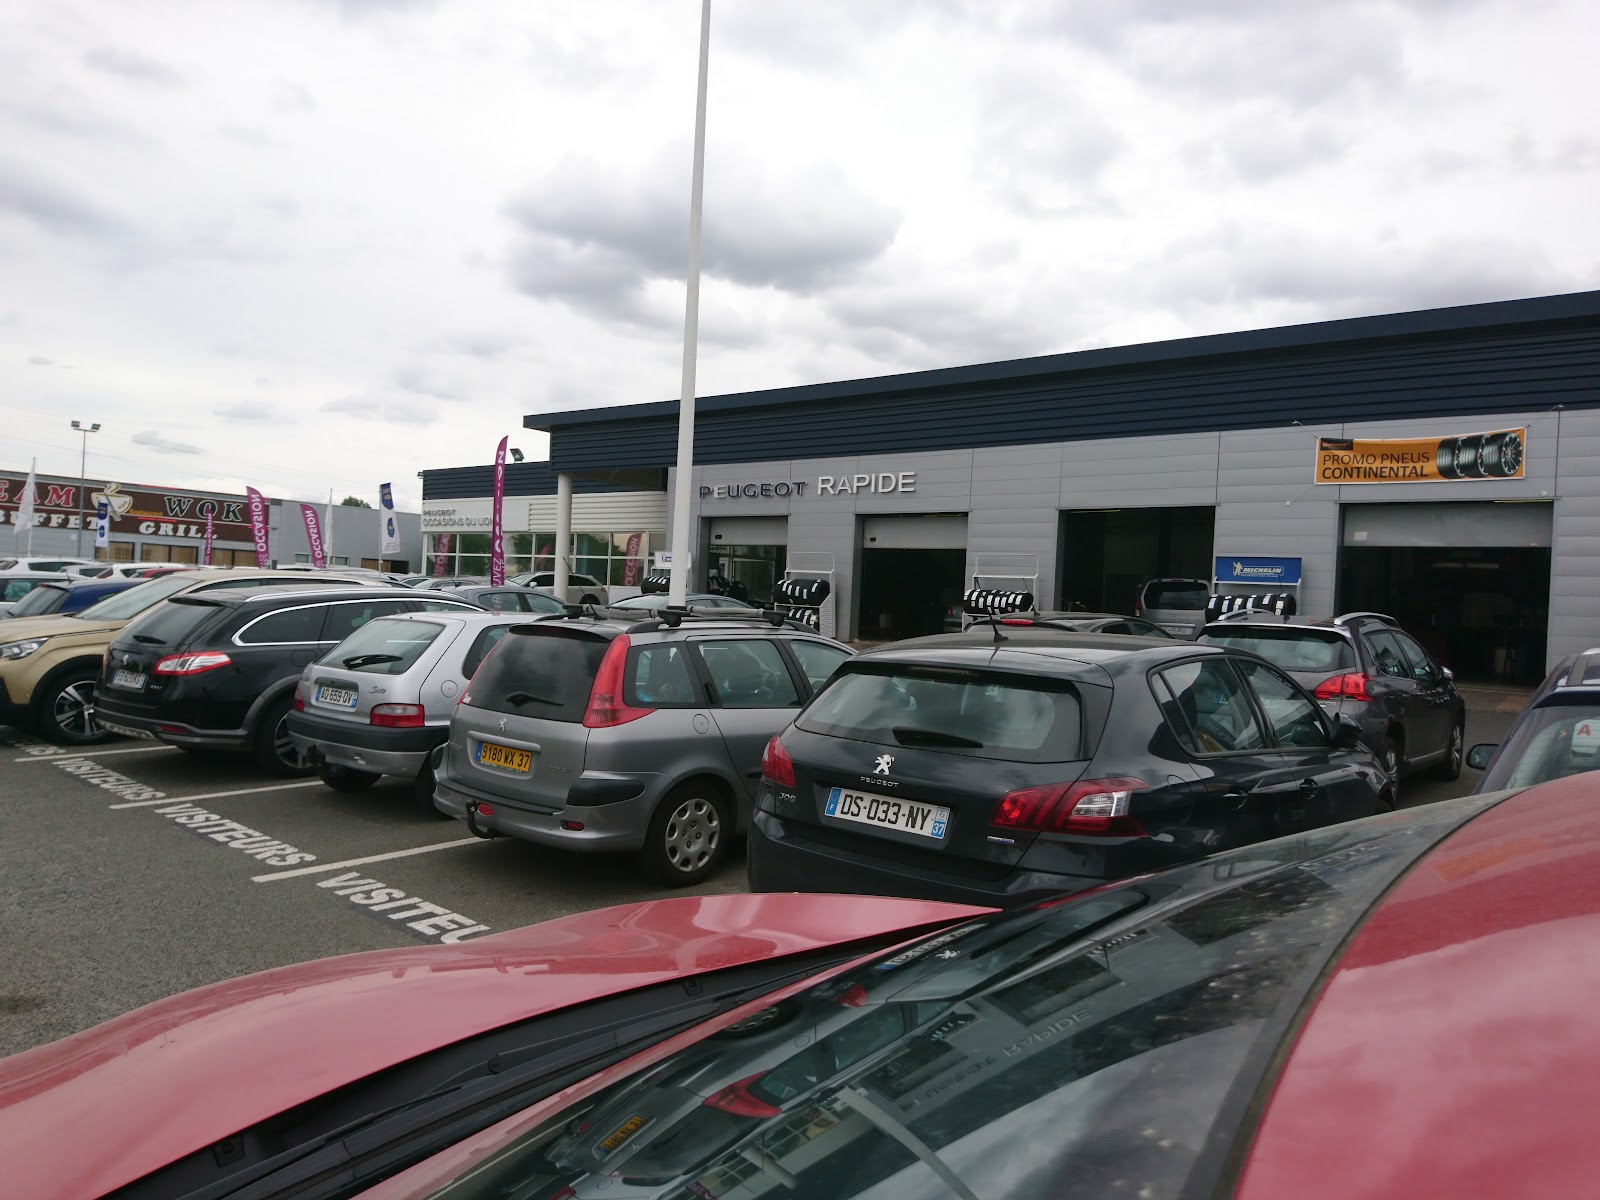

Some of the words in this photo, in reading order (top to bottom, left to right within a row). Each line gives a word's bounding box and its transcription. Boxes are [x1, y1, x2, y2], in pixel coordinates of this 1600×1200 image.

[1323, 453, 1376, 466] PROMO
[1381, 452, 1430, 464] PNEUS
[1322, 466, 1429, 479] CONTINENTAL
[699, 481, 808, 499] PEUGEOT
[817, 472, 916, 495] RAPIDE
[164, 496, 242, 521] WOK
[423, 518, 464, 527] OCCASIONS
[481, 745, 502, 761] 9180
[503, 749, 516, 766] WX
[517, 752, 530, 768] 37
[52, 757, 167, 800] VISITEURS
[861, 776, 899, 787] PEUGEOT
[154, 803, 317, 866] VISITEURS
[932, 822, 945, 835] 37
